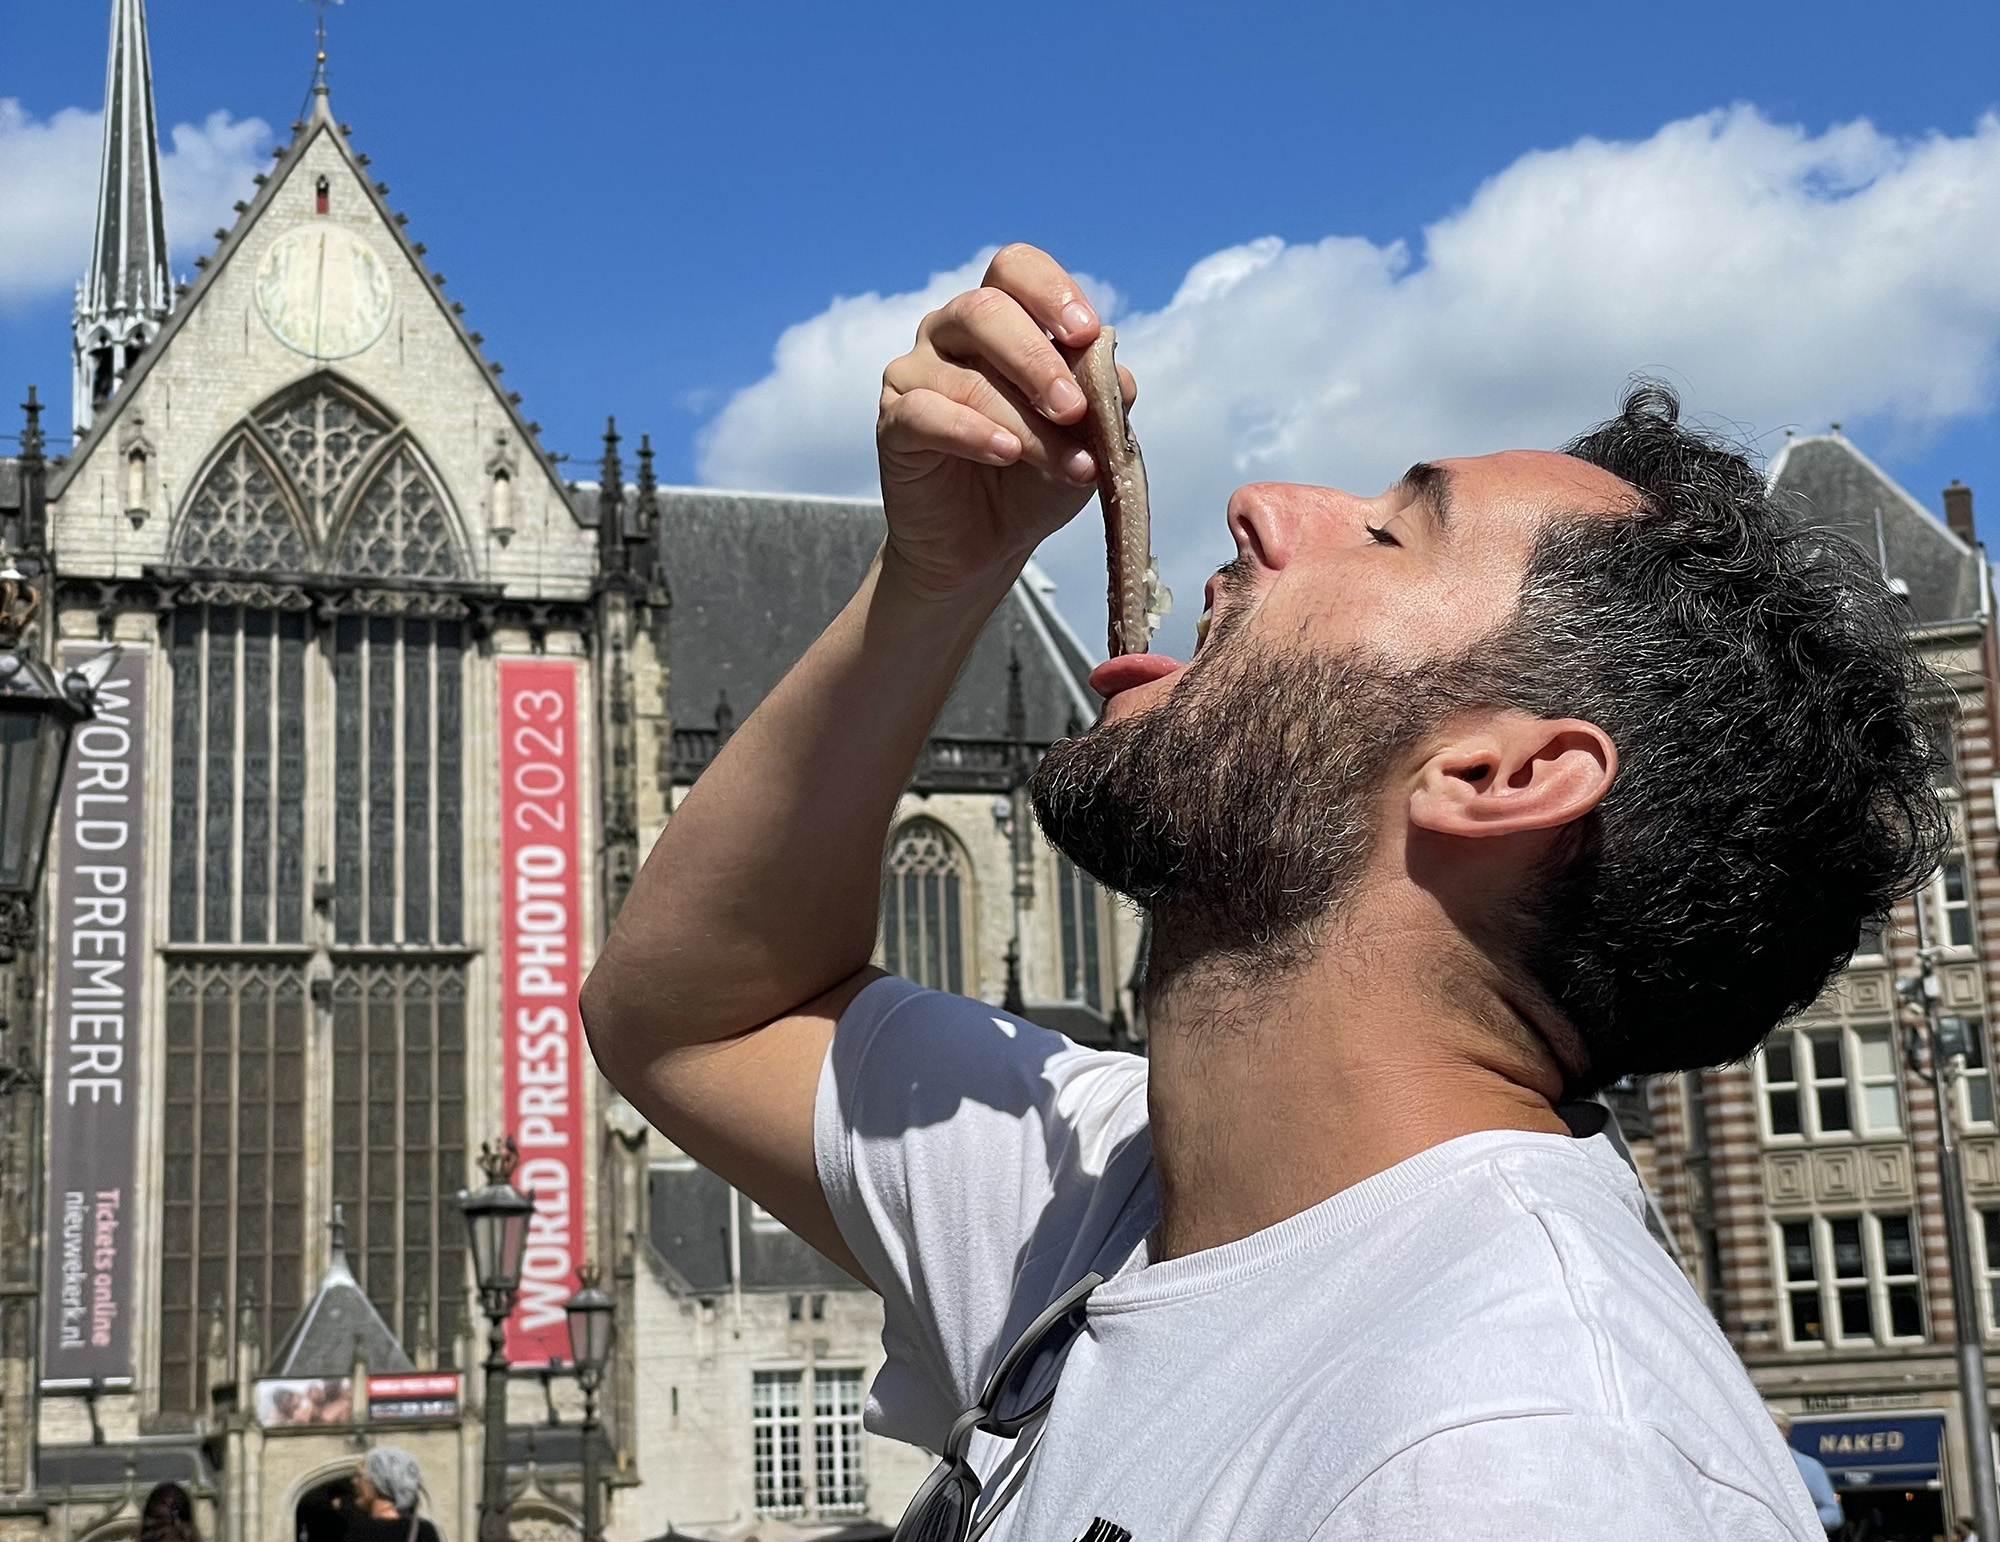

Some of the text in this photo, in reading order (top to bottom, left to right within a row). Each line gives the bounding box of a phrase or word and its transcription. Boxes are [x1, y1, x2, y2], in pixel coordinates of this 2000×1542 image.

[68, 679, 131, 1106] WORLD PREMIERE
[513, 688, 572, 1332] WORLD PRESS PHOTO 2023
[59, 1190, 90, 1350] nieuwekerk.nl
[91, 1187, 121, 1348] Tickets online
[1818, 1430, 1905, 1454] NAKED
